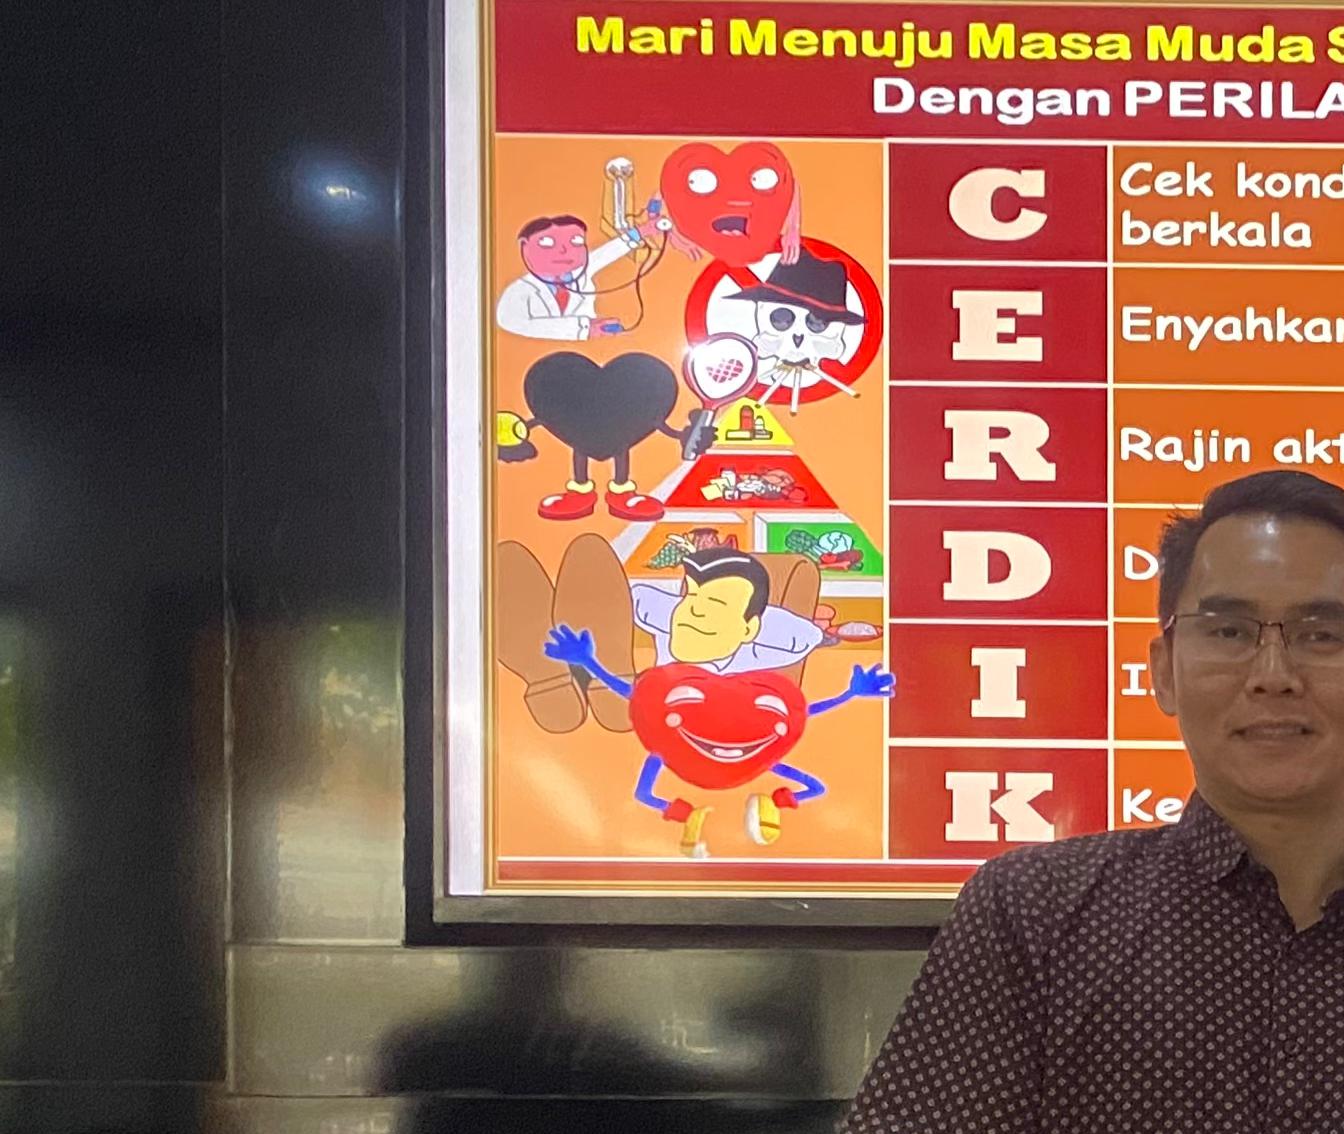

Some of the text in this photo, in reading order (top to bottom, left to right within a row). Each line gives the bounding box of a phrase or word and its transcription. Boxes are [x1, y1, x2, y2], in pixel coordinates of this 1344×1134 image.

[576, 16, 714, 56] Mari
[729, 19, 953, 69] Menuju
[968, 22, 1132, 63] Masa
[1146, 25, 1314, 65] Muda
[873, 77, 1112, 126] Dengan
[948, 167, 1049, 242] C
[1121, 161, 1215, 198] Cek
[1121, 209, 1313, 250] berkala
[952, 290, 1044, 363] E
[944, 410, 1058, 483] R
[1120, 428, 1252, 474] Rajin
[942, 530, 1053, 602] D
[970, 647, 1028, 720] I
[945, 771, 1057, 843] K
